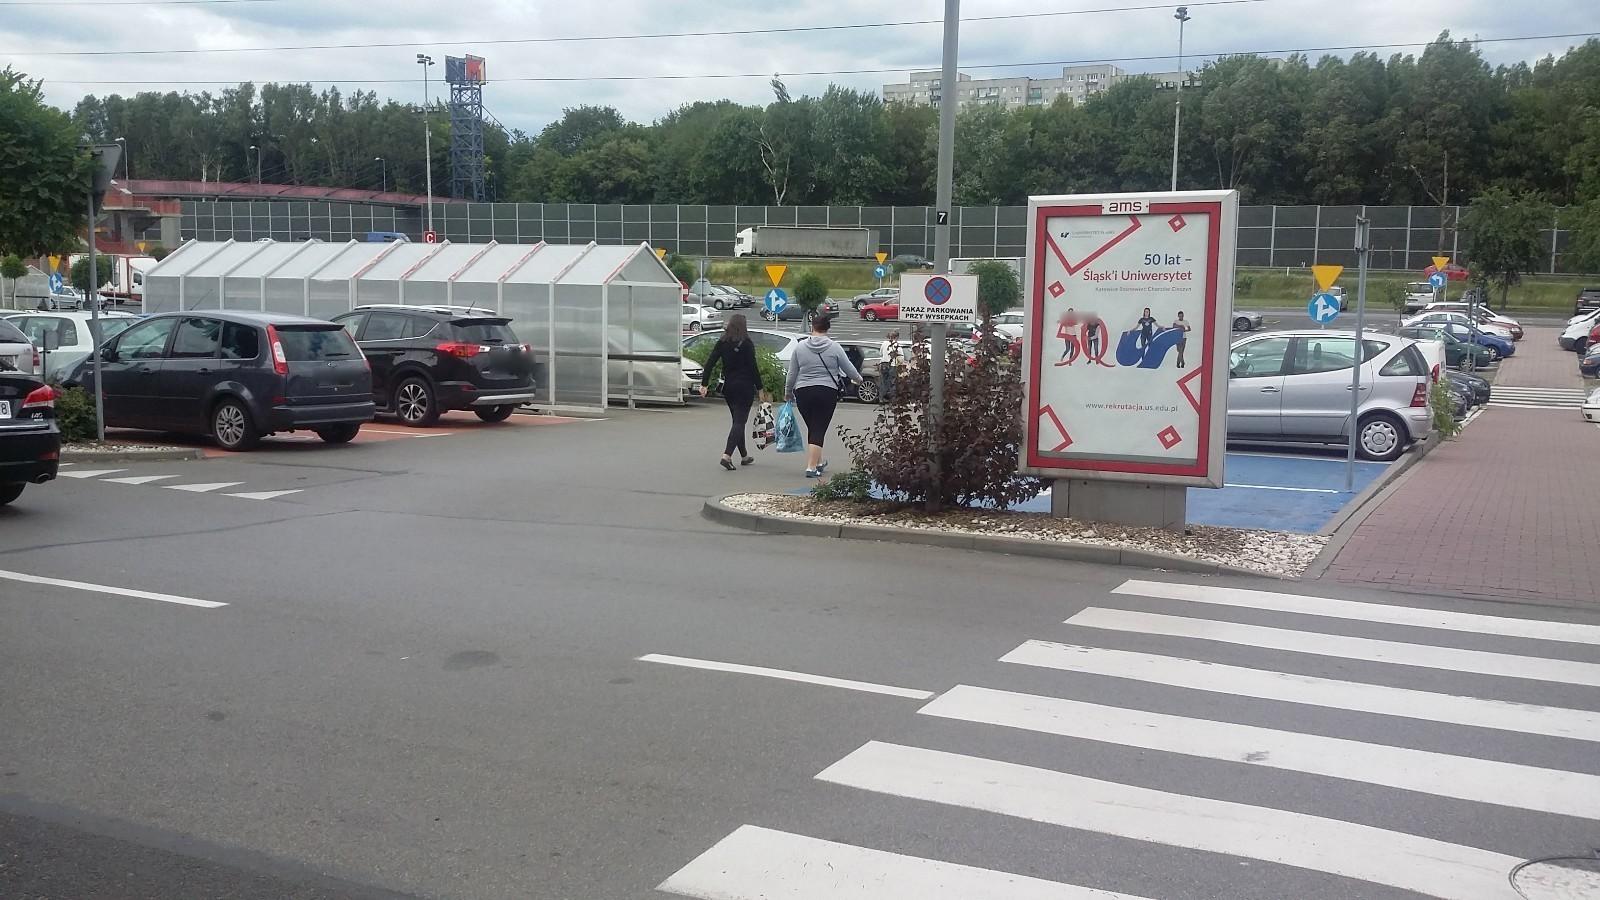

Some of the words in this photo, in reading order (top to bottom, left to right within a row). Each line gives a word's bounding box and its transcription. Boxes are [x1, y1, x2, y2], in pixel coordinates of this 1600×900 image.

[1109, 201, 1142, 212] ams
[938, 212, 946, 222] 7
[1144, 253, 1160, 266] 50
[1164, 253, 1181, 265] lat
[1121, 270, 1192, 282] Uniwersytet
[1085, 402, 1178, 412] www.rekrutacja.us.edu.pl
